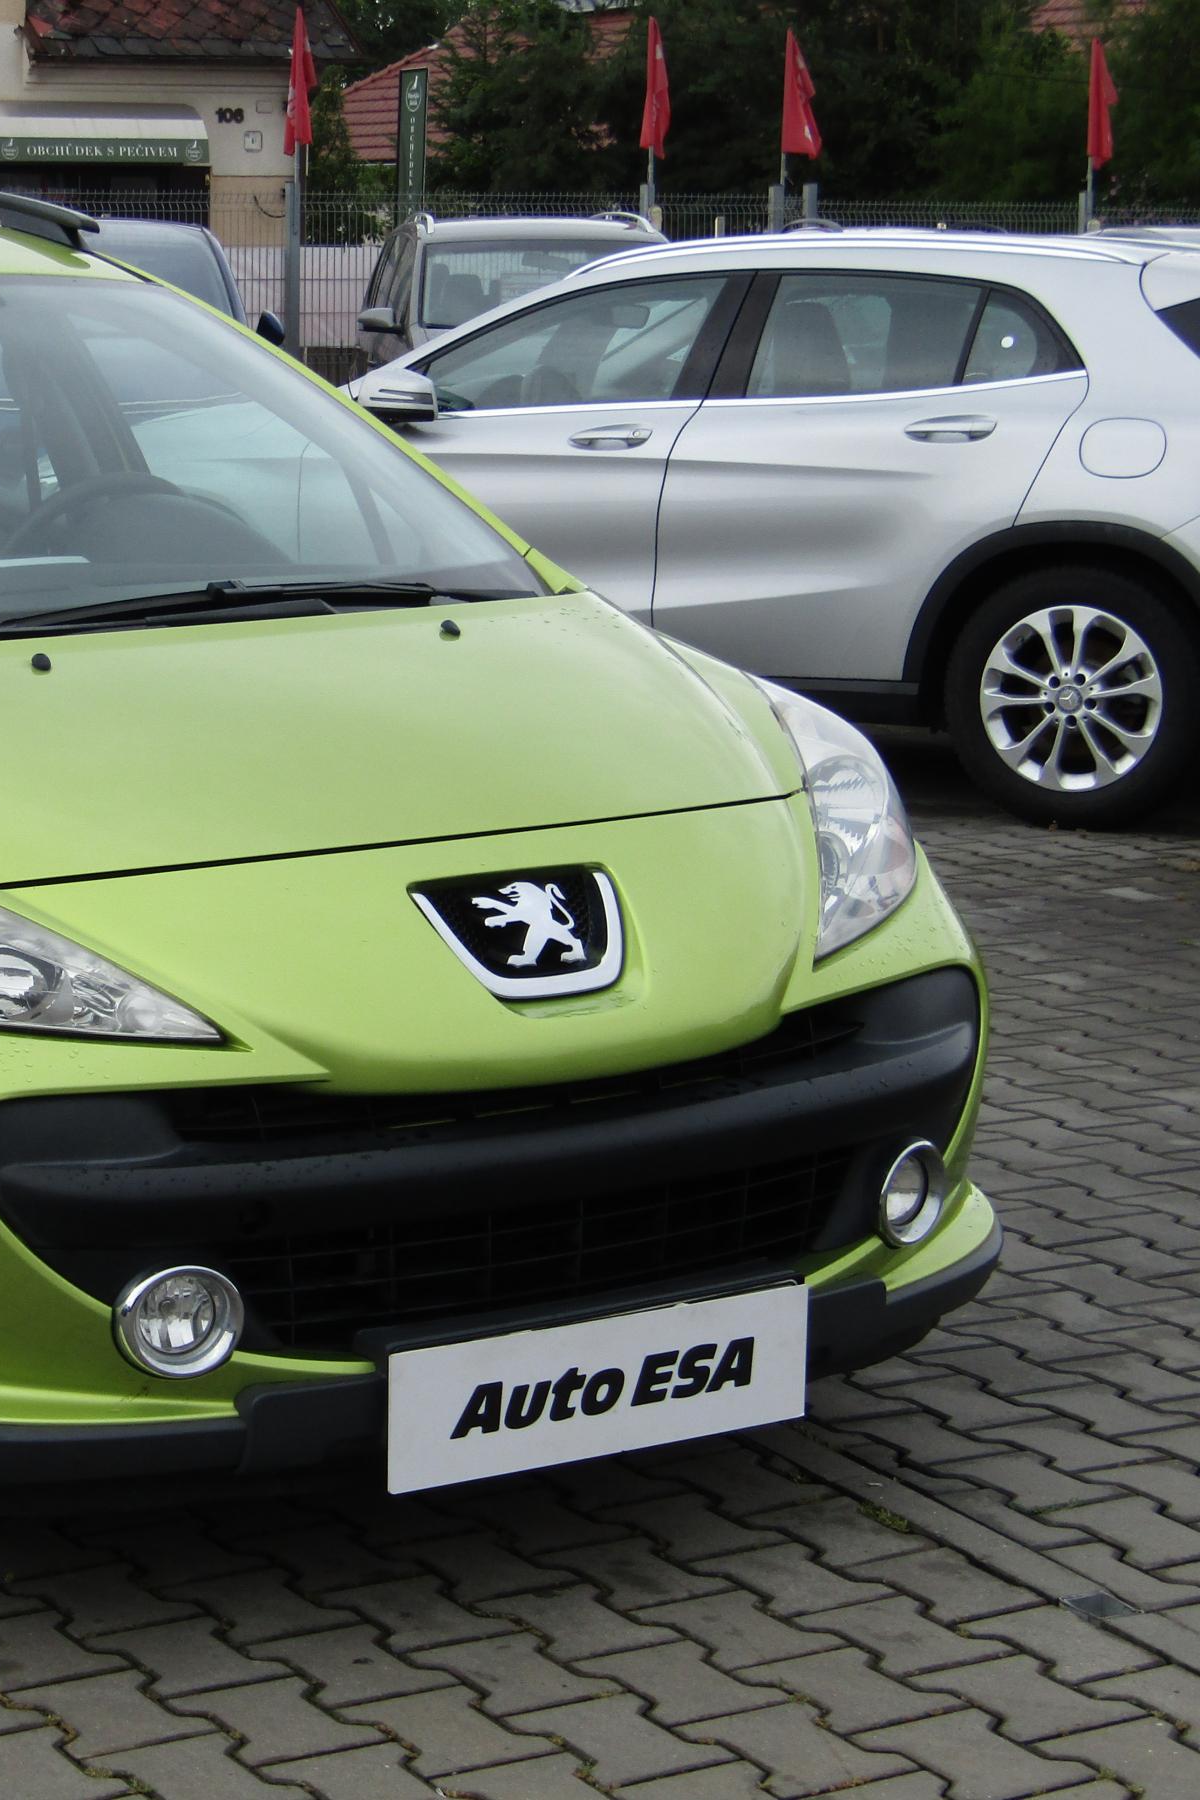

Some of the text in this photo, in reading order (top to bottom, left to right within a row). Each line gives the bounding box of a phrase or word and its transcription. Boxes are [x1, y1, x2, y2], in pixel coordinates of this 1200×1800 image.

[26, 143, 102, 158] OBCHŮDEK
[107, 145, 115, 157] S
[119, 143, 178, 158] PEČIVEM
[450, 1336, 755, 1440] Auto ESA
